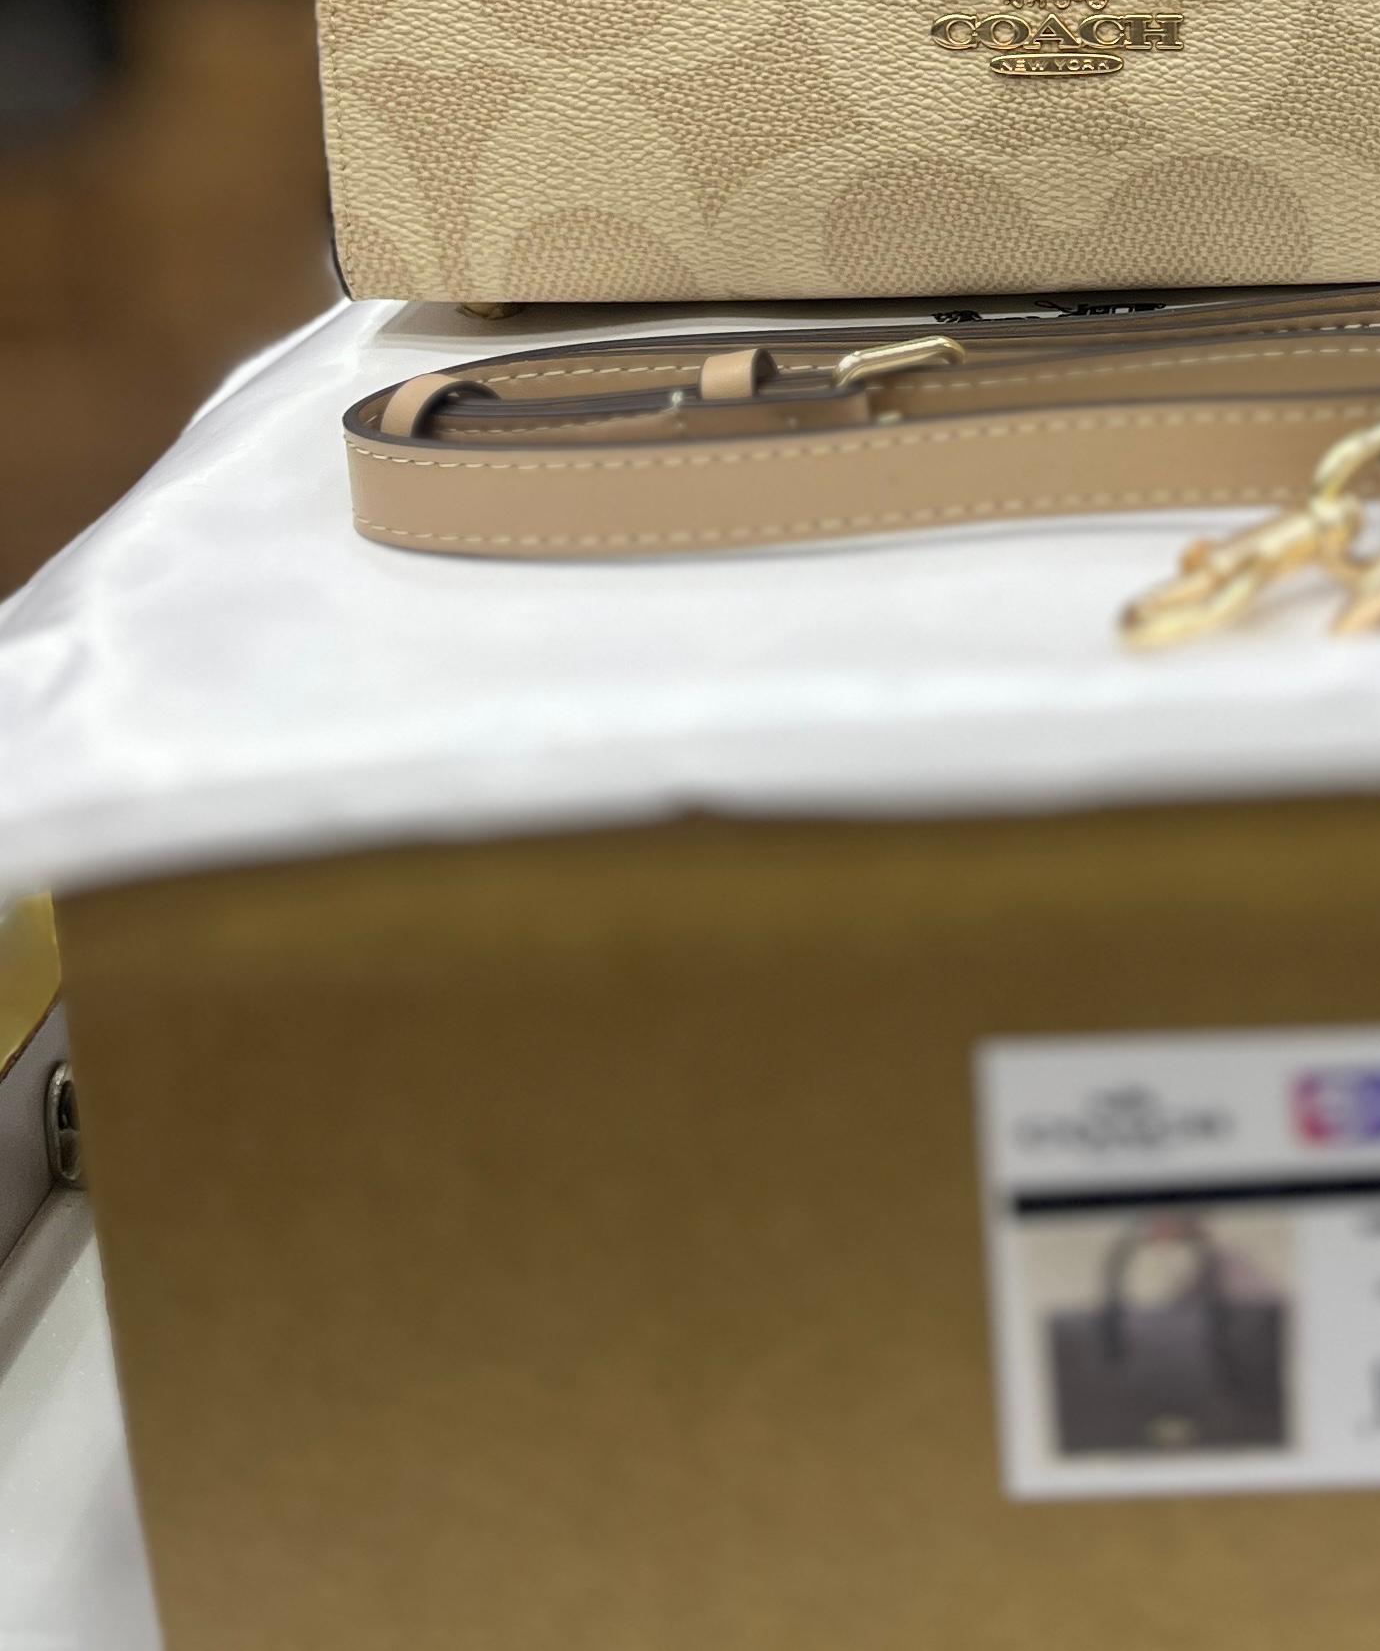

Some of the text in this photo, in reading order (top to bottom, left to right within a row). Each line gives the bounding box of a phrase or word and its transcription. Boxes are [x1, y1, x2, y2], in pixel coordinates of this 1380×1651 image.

[930, 13, 1185, 50] COACH
[1000, 58, 1110, 72] NEW YORK
